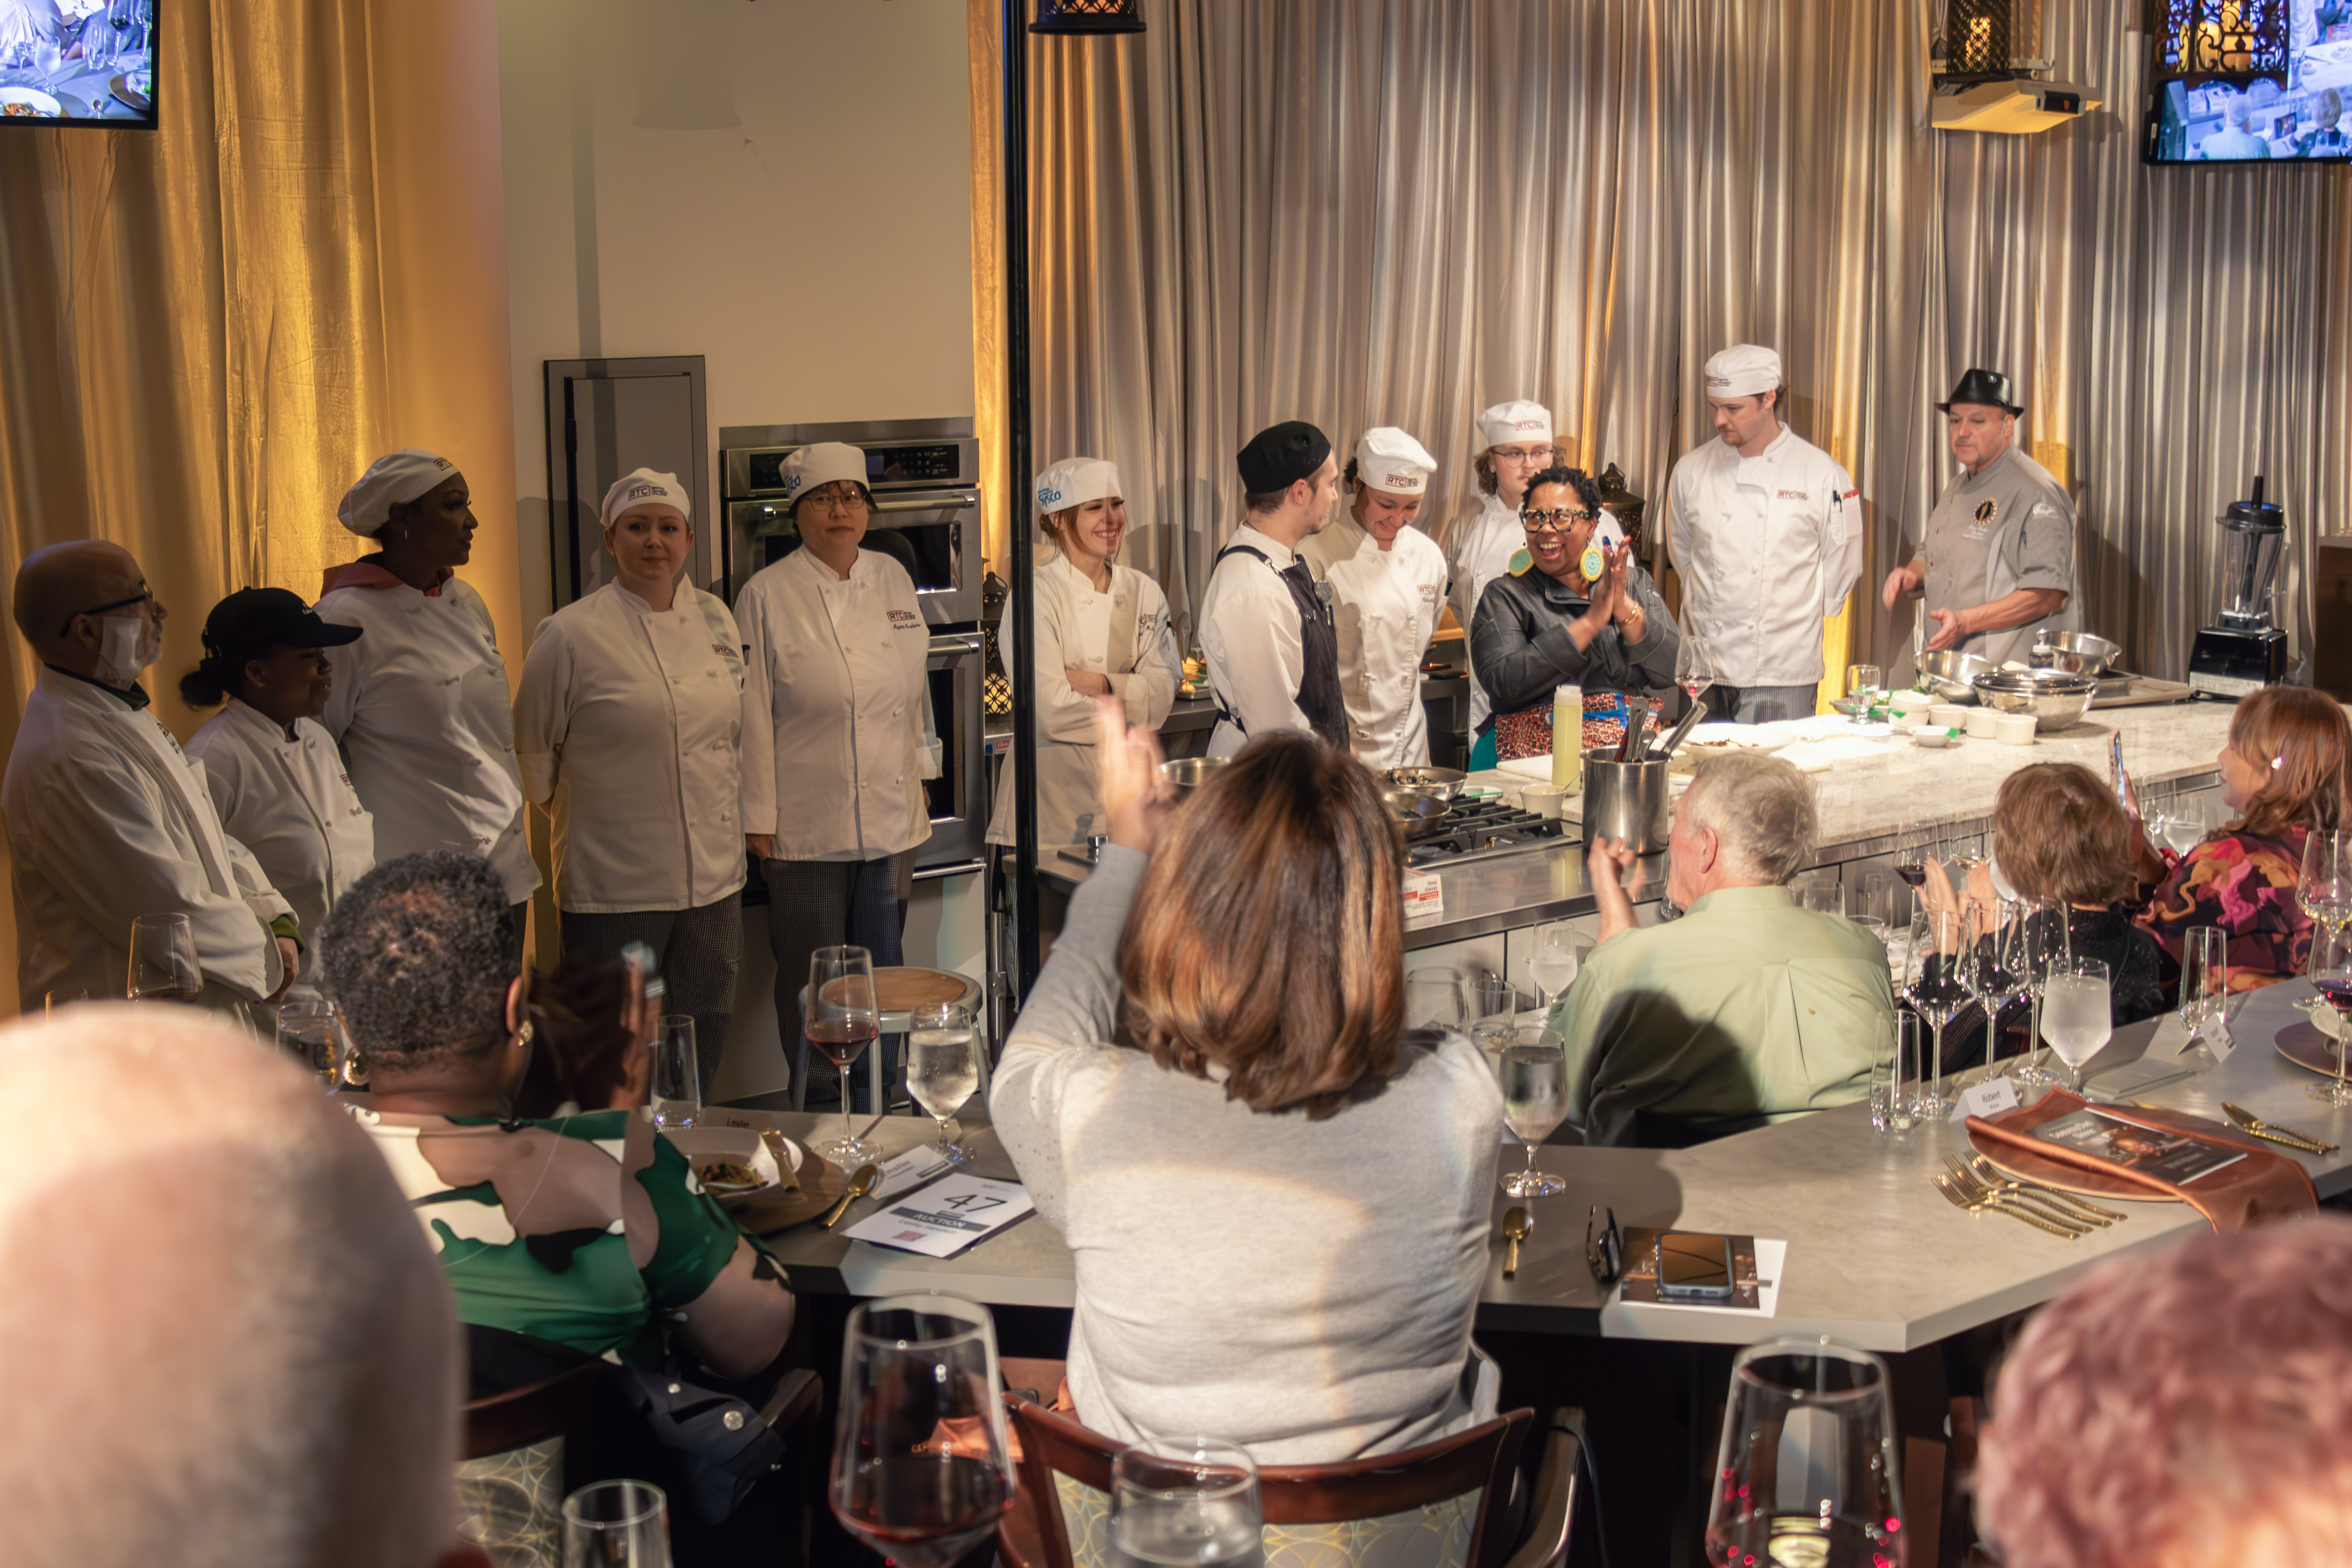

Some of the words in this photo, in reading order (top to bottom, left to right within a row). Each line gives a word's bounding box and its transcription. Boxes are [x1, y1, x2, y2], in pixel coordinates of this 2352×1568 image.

[1388, 476, 1404, 486] RTC
[630, 488, 648, 498] RTC
[714, 646, 729, 655] RTC
[1981, 1091, 2001, 1103] Robert
[944, 1194, 1008, 1212] 47
[913, 1214, 966, 1228] AUCTION
